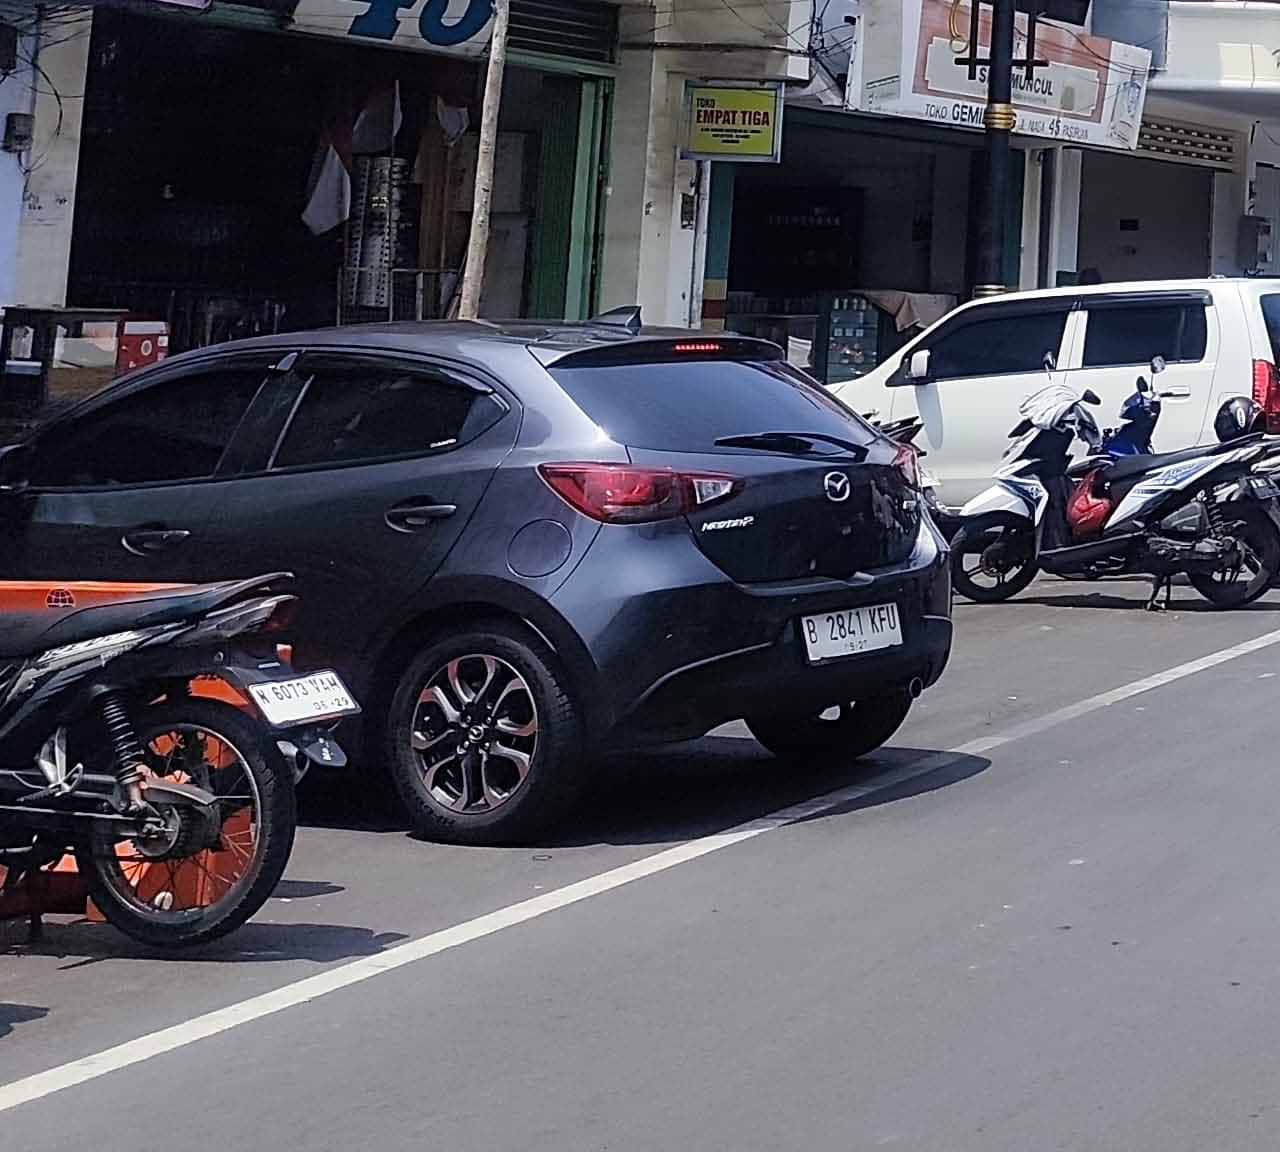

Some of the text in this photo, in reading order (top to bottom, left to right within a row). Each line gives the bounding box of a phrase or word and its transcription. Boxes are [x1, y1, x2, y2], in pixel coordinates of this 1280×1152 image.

[696, 109, 770, 126] EMPAT TIGA
[925, 104, 948, 119] TOKO
[806, 605, 897, 644] B 2841 KFU
[271, 681, 309, 701] 6073
